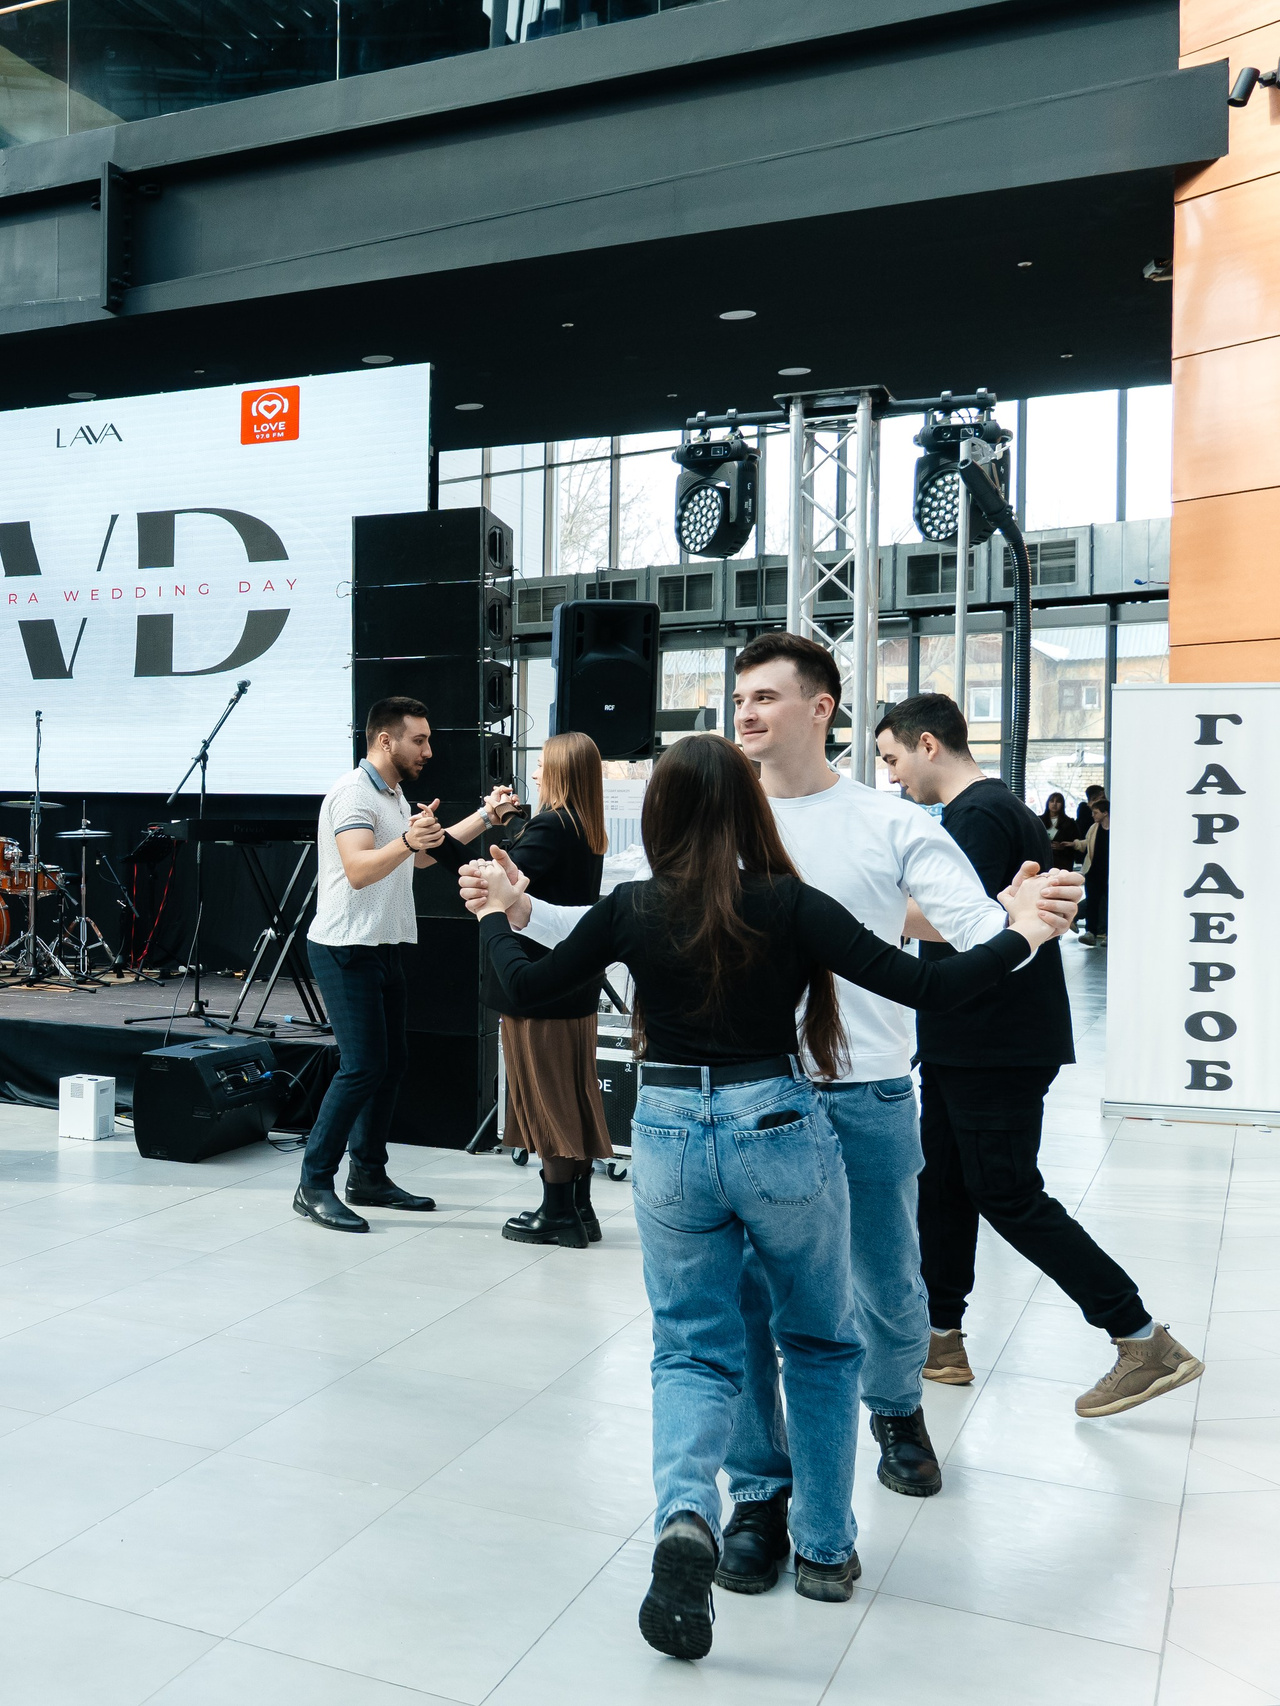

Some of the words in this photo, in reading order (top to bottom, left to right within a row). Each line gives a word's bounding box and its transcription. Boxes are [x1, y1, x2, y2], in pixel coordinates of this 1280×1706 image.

[56, 423, 123, 448] LAVA
[253, 421, 286, 433] LOVE
[63, 583, 210, 602] WEDDING
[238, 578, 297, 593] DAY
[1183, 713, 1247, 1092] ГАРДЕРОБ
[615, 1037, 625, 1048] 2
[624, 1063, 633, 1073] 2
